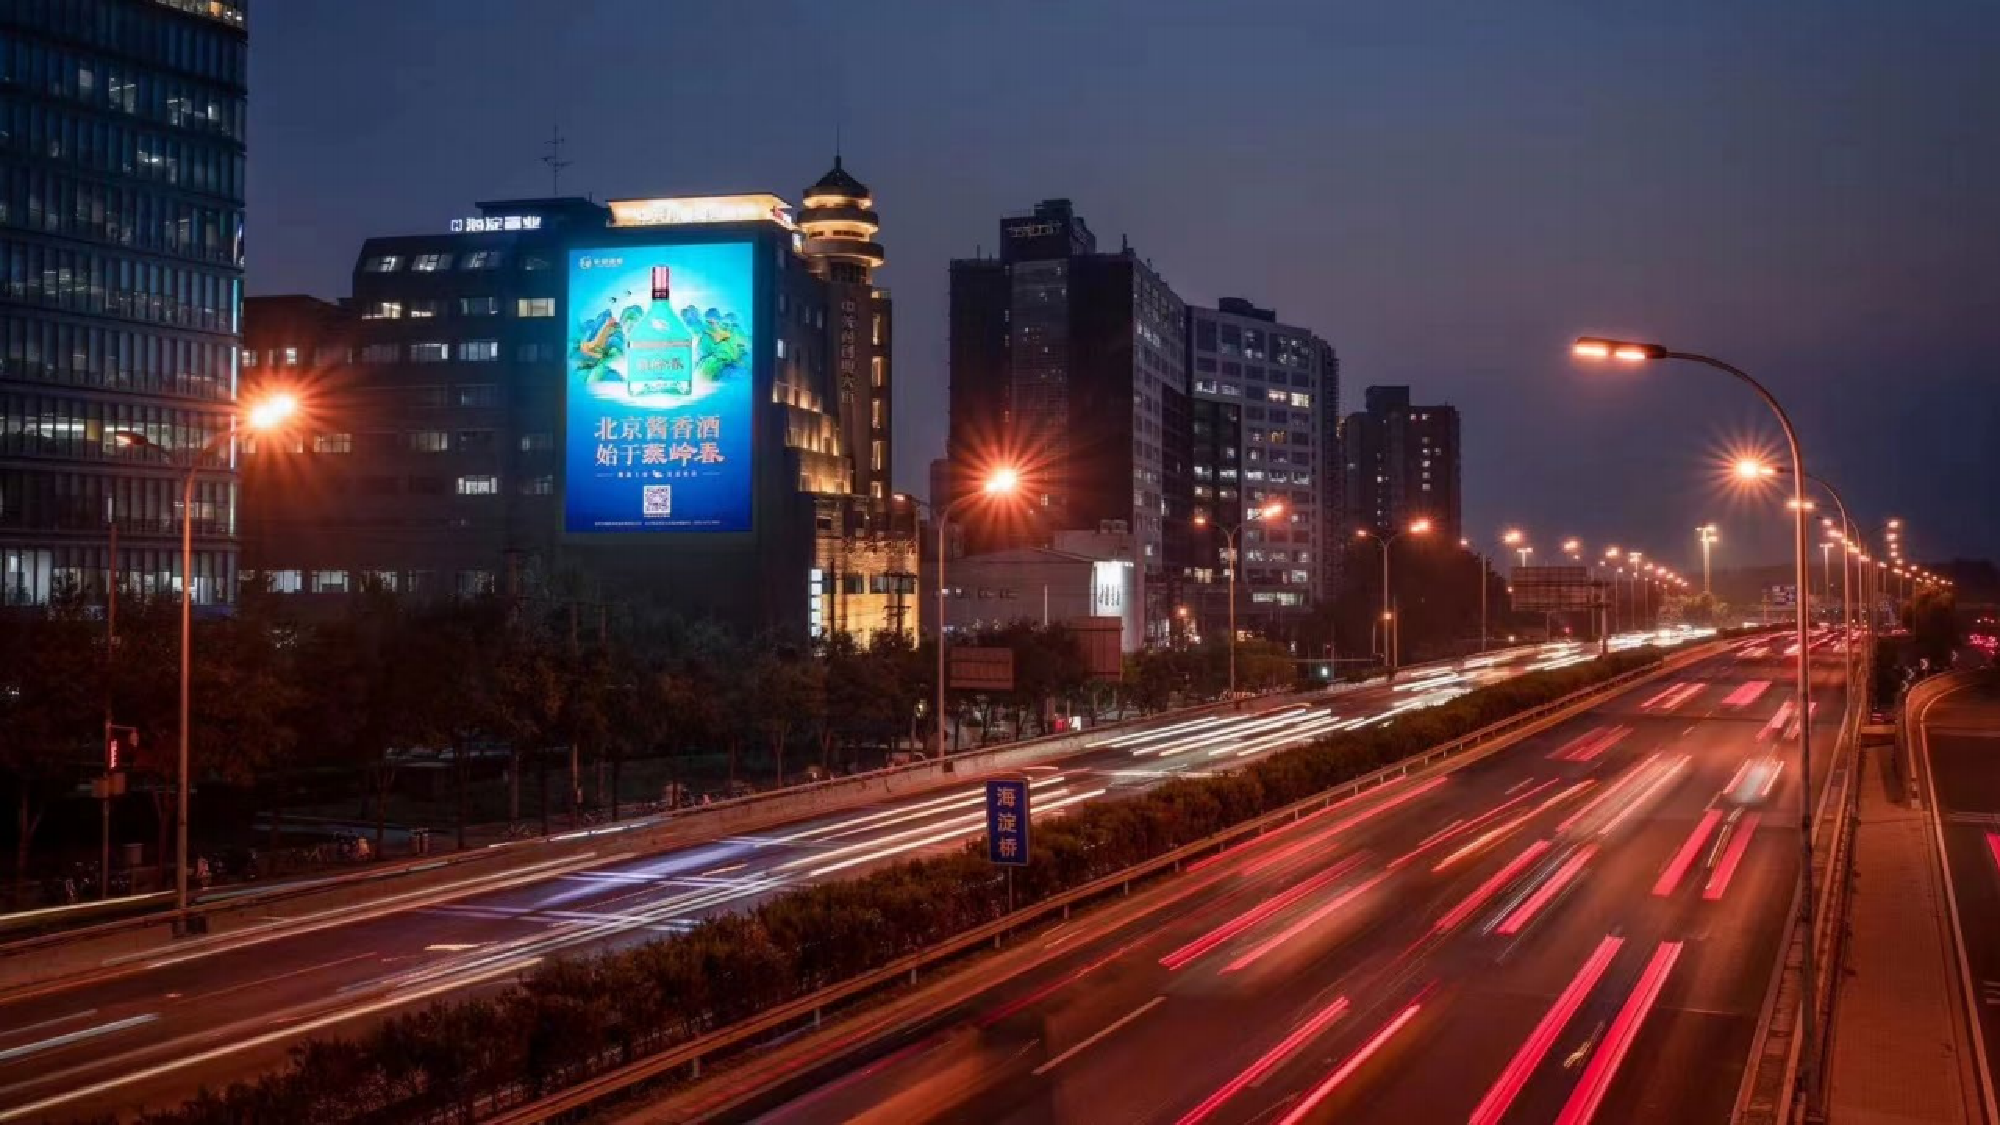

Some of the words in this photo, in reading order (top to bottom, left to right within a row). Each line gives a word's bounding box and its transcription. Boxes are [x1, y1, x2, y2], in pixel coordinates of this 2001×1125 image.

[594, 416, 720, 441] 北京酱香酒
[997, 786, 1017, 857] 海淀桥
